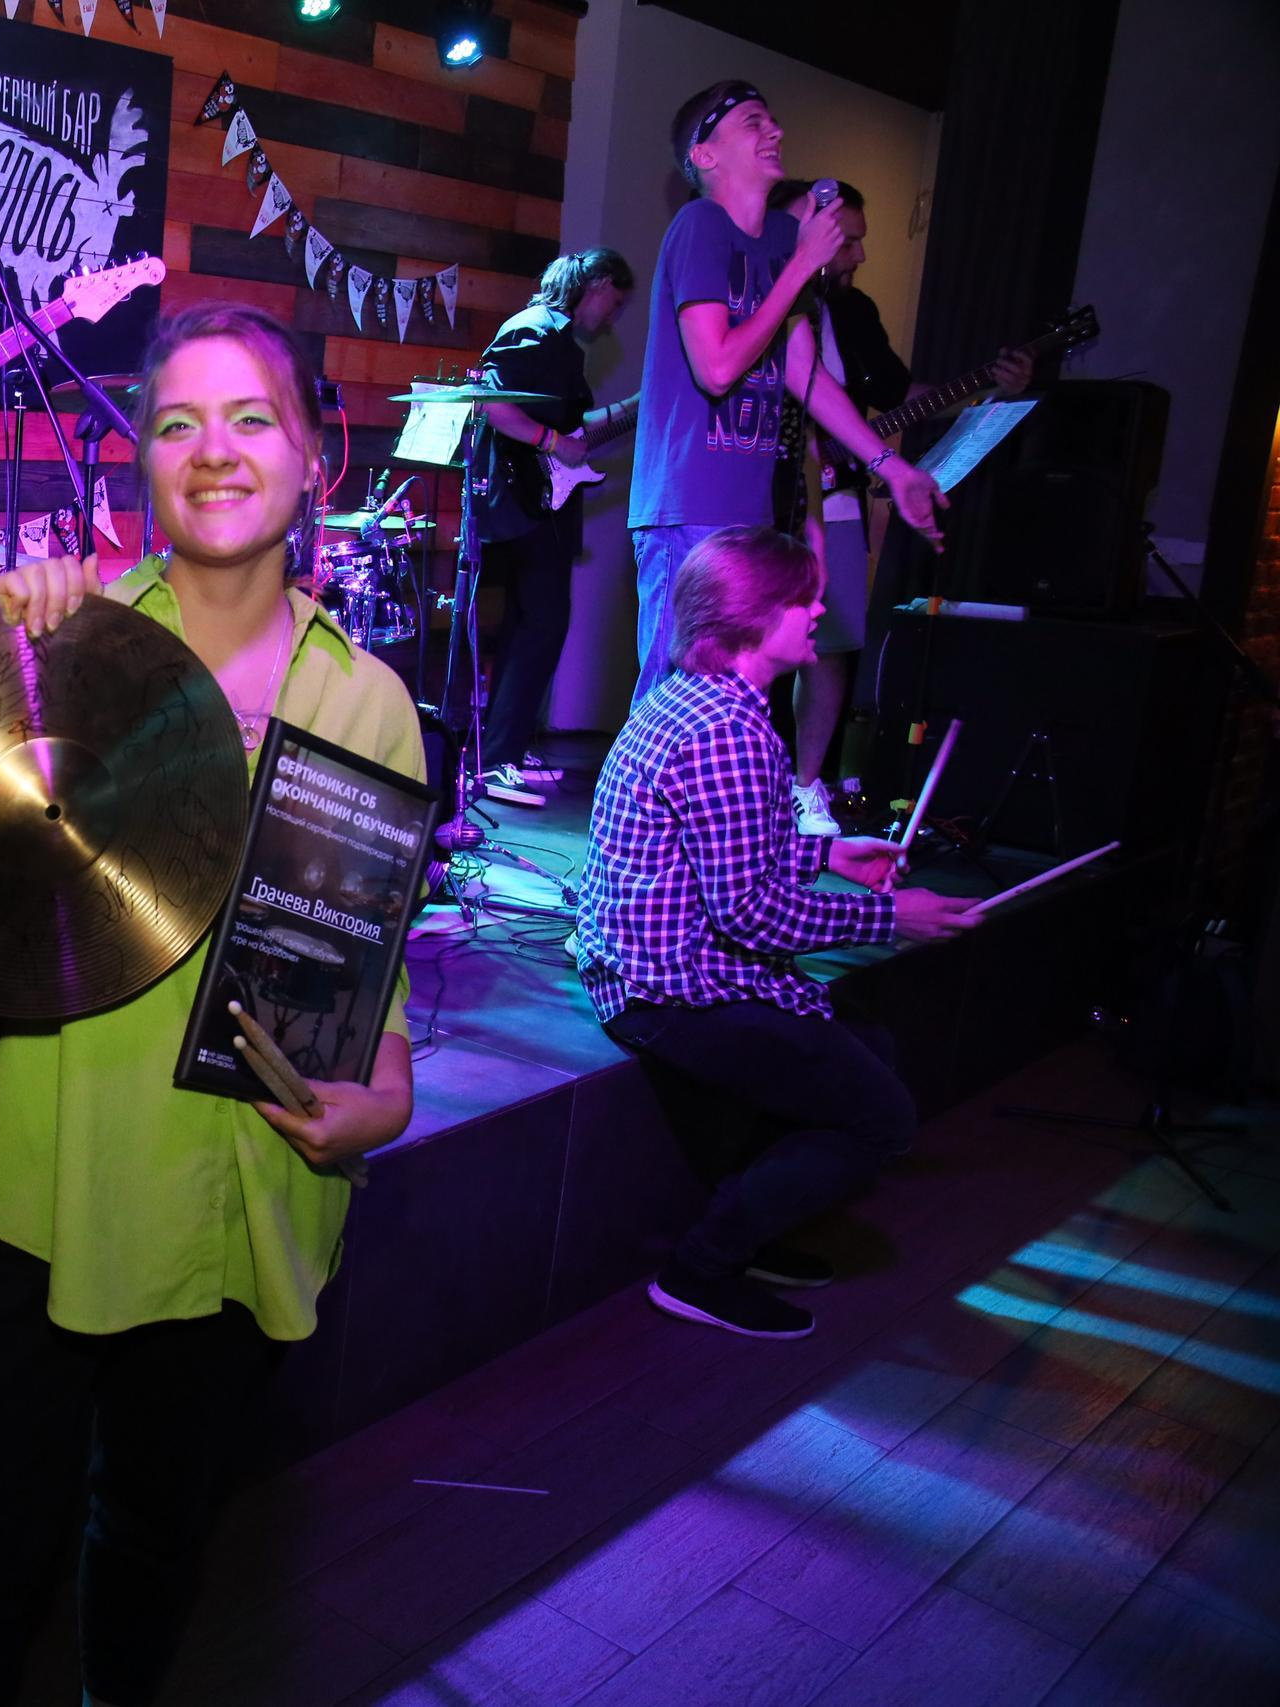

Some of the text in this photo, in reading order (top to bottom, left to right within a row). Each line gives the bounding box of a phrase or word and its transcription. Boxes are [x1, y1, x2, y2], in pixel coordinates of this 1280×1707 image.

[61, 88, 102, 156] БАР
[271, 778, 415, 848] ОКОНЧАНИИ ОБУЧЕНИЯ
[277, 755, 377, 809] СЕРТИФИКАТ ОБ
[250, 876, 381, 940] Грачева Виктория
